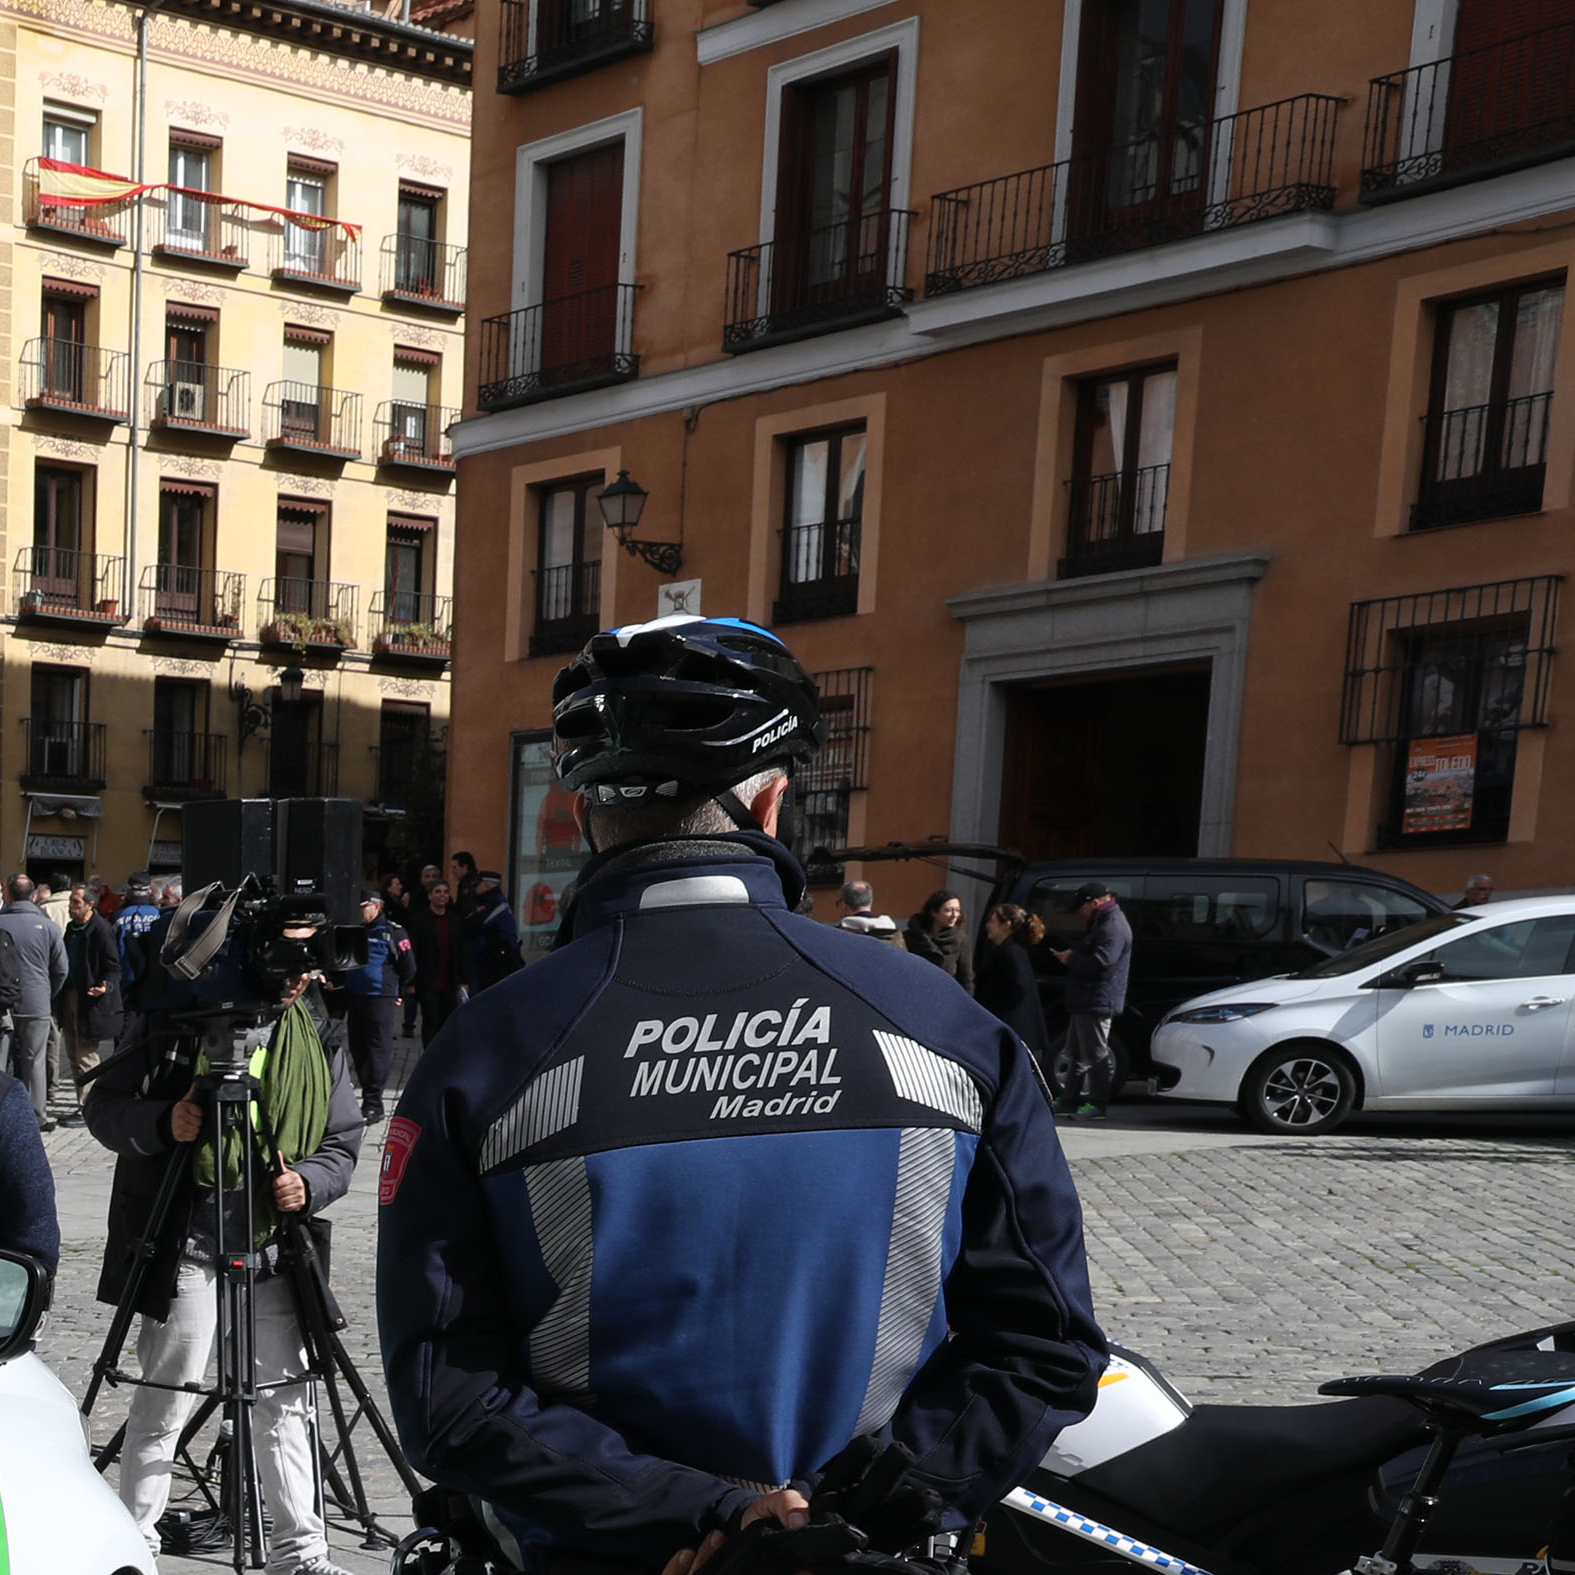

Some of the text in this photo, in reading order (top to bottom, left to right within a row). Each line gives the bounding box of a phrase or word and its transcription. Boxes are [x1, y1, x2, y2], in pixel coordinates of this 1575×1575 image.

[752, 715, 798, 753] POLICÍA
[623, 998, 831, 1058] POLICÍA
[1444, 1024, 1515, 1036] MADRID
[629, 1048, 842, 1097] MUNICIPAL
[709, 1090, 842, 1119] Madrid
